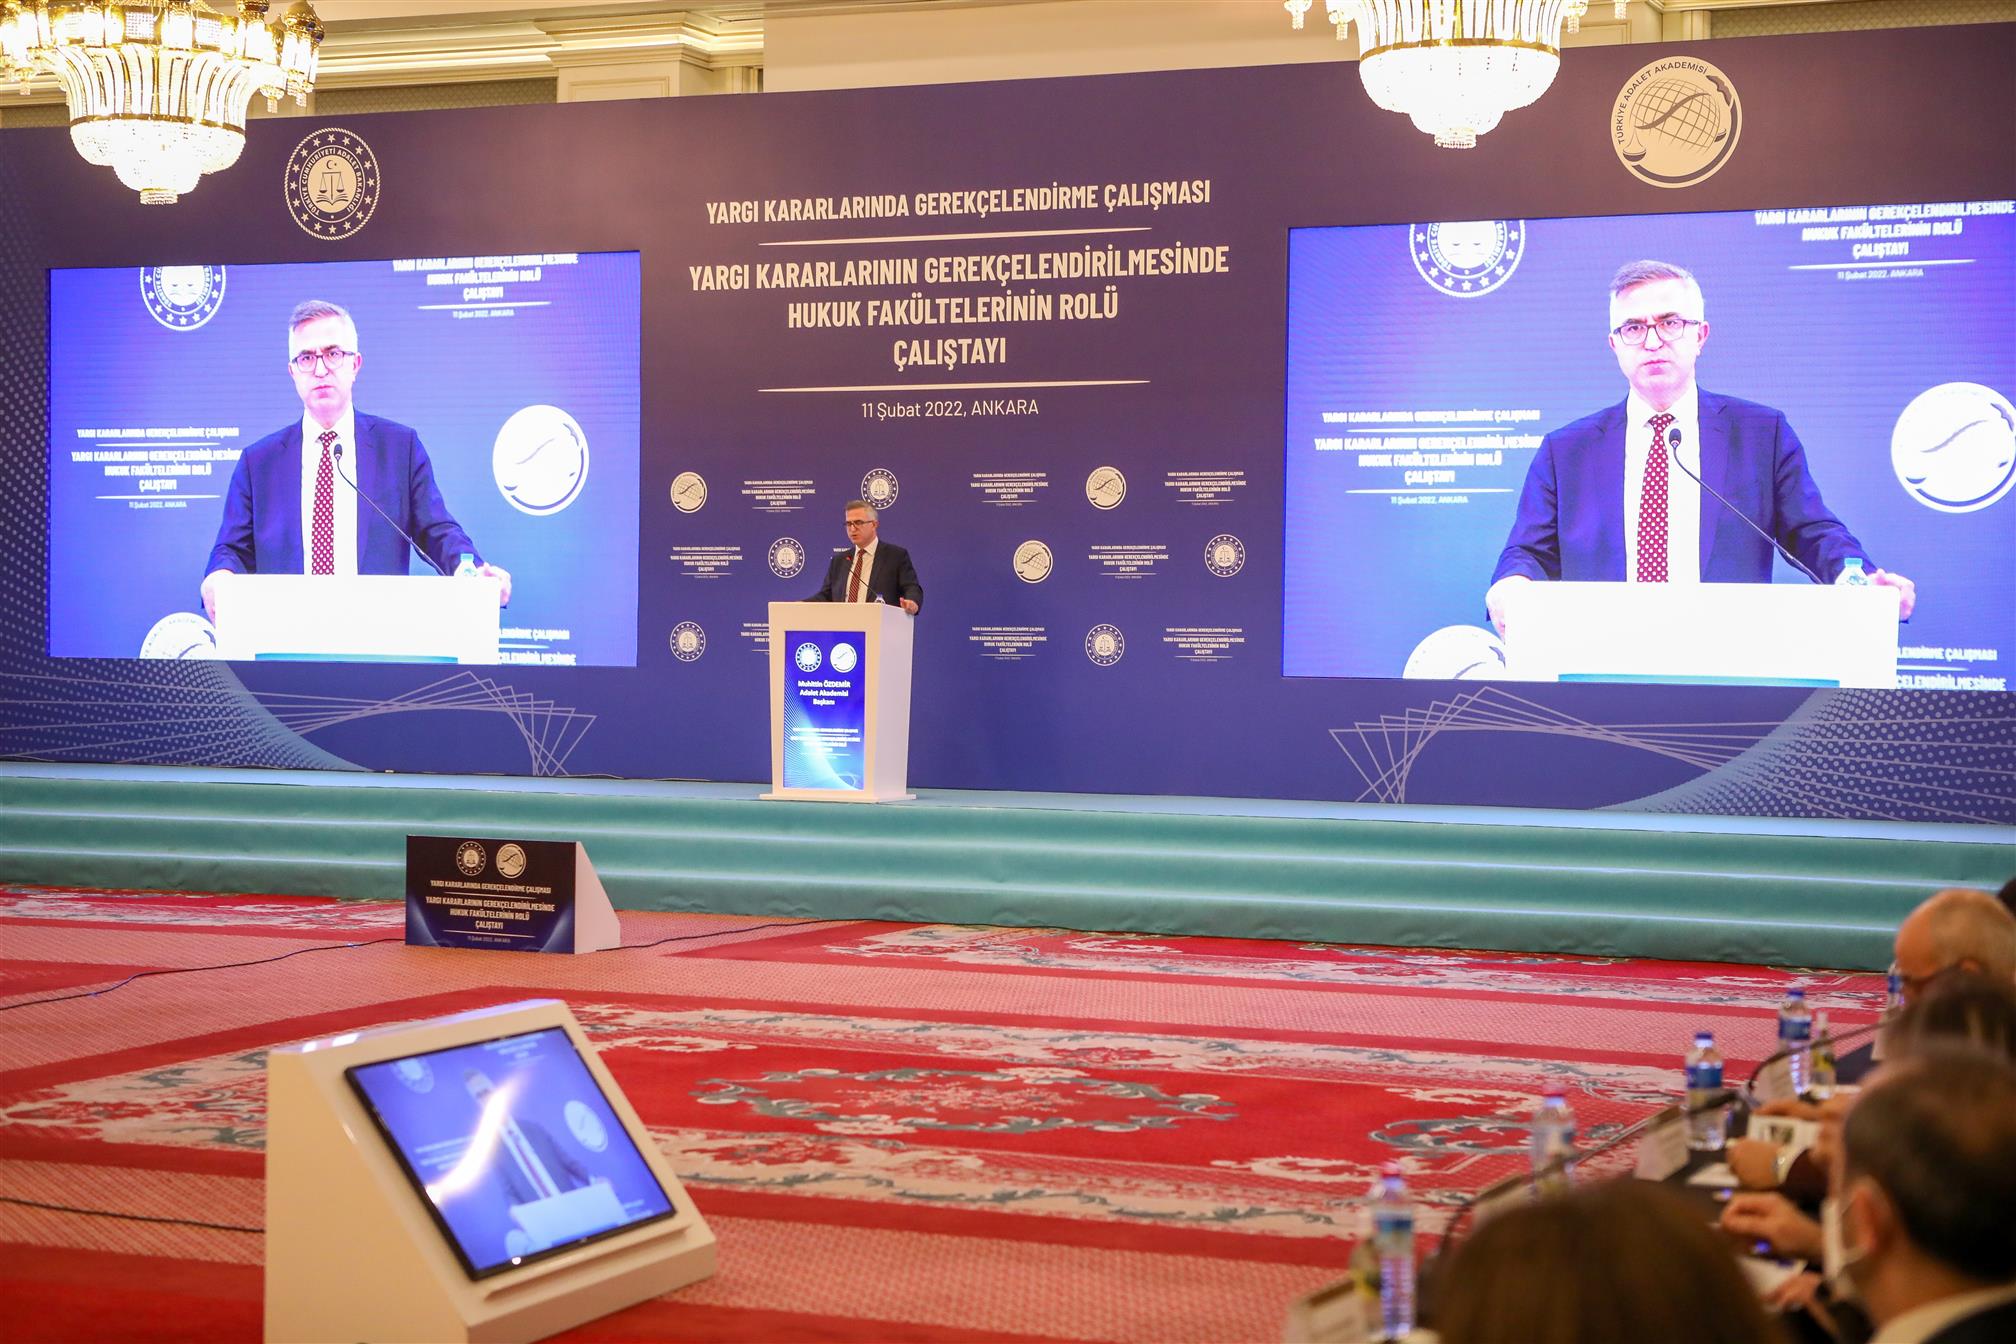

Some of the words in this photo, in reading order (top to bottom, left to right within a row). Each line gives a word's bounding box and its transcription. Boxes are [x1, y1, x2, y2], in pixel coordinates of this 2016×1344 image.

[1624, 70, 1652, 101] ADALET
[707, 200, 758, 224] YARGI
[764, 195, 909, 222] KARARLARINDA
[915, 182, 1098, 219] GEREKÇELENDİRME
[1104, 180, 1210, 212] ÇALIŞMASI
[690, 265, 749, 291] YARGI
[757, 258, 918, 289] KARARLARININ
[925, 241, 1229, 287] GEREKÇELENDİRİLMESİNDE
[788, 300, 861, 328] HUKUK
[868, 289, 1052, 326] FAKÜLTELERİNİN
[1059, 286, 1118, 319] ROLÜ
[894, 338, 1006, 371] ÇALIŞTAYI
[862, 403, 872, 418] 11
[877, 402, 921, 421] Şubat
[925, 401, 967, 419] 2022,
[971, 399, 1039, 416] ANKARA
